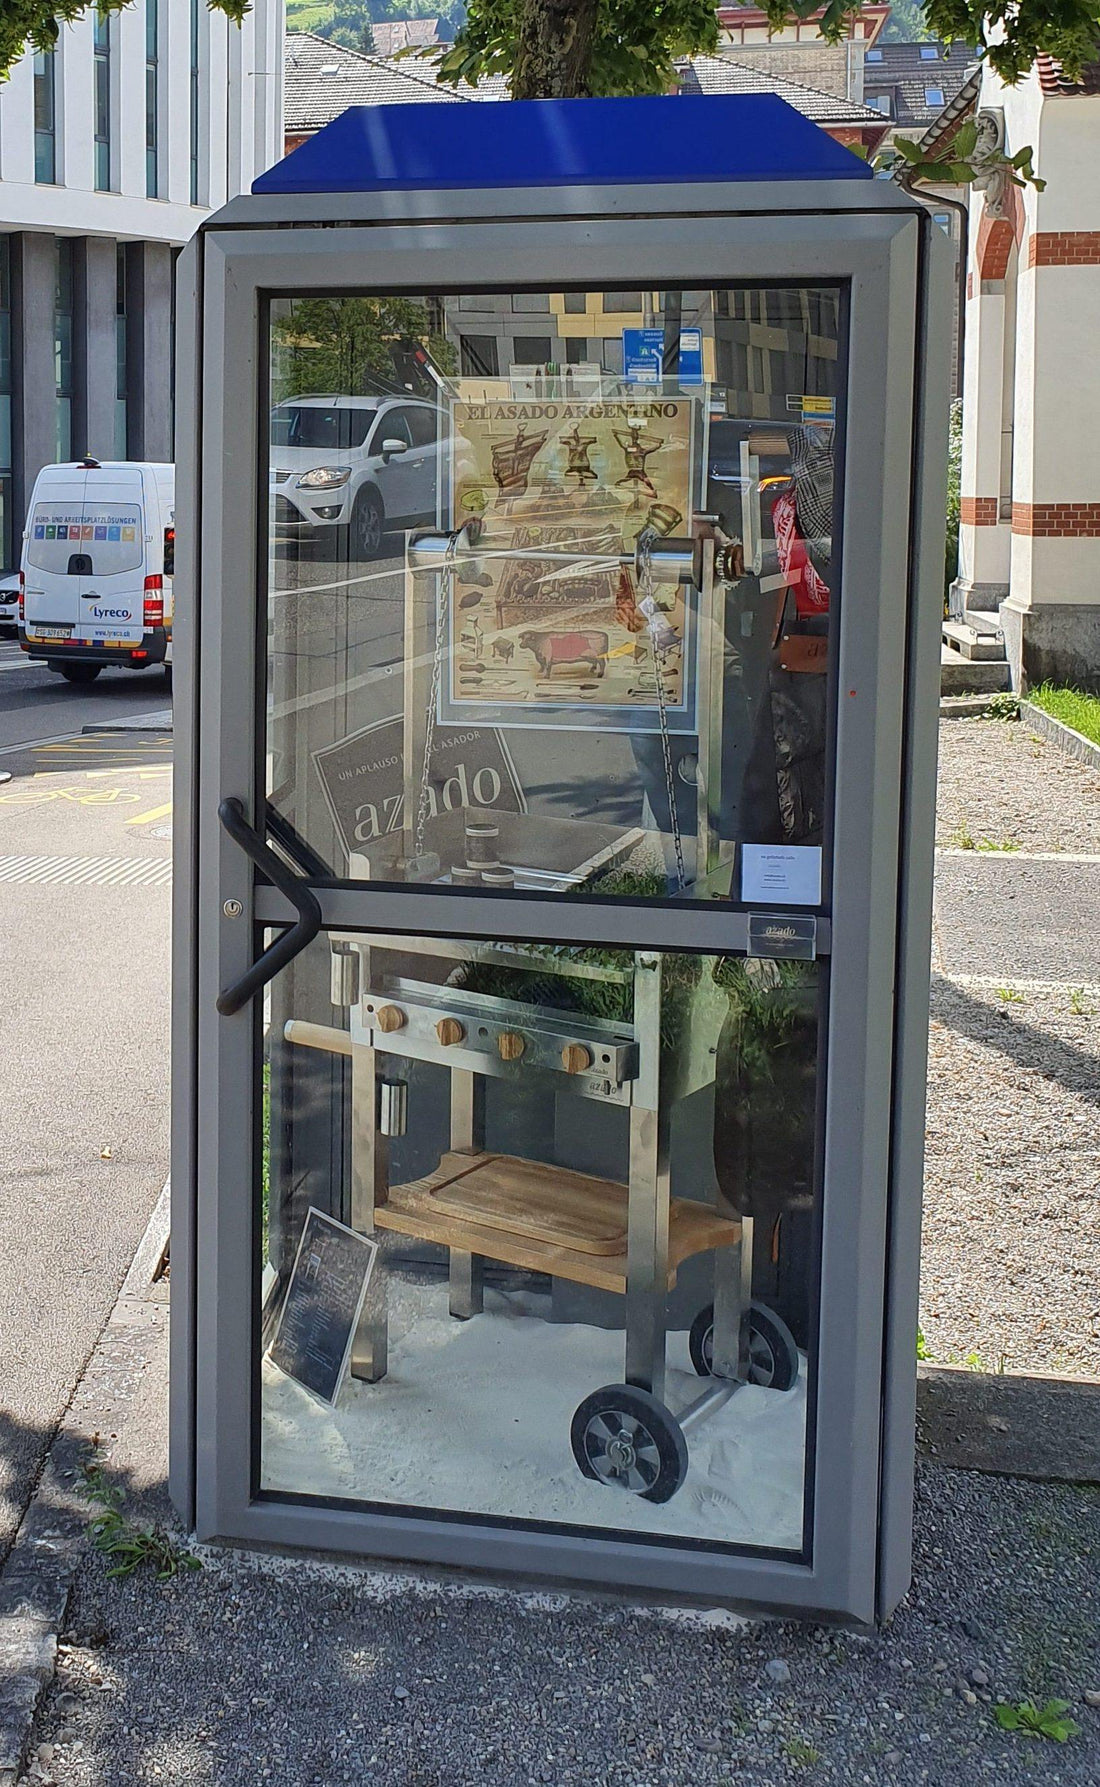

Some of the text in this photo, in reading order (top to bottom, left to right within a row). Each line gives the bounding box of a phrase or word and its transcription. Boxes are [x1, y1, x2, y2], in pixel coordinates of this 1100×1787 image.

[467, 403, 679, 420] EL ASADO ARGENTINO
[93, 606, 129, 620] Lyreco
[338, 769, 354, 782] UN
[355, 754, 399, 777] APLAUSO
[440, 729, 482, 750] ASADOR
[765, 925, 796, 937] azado
